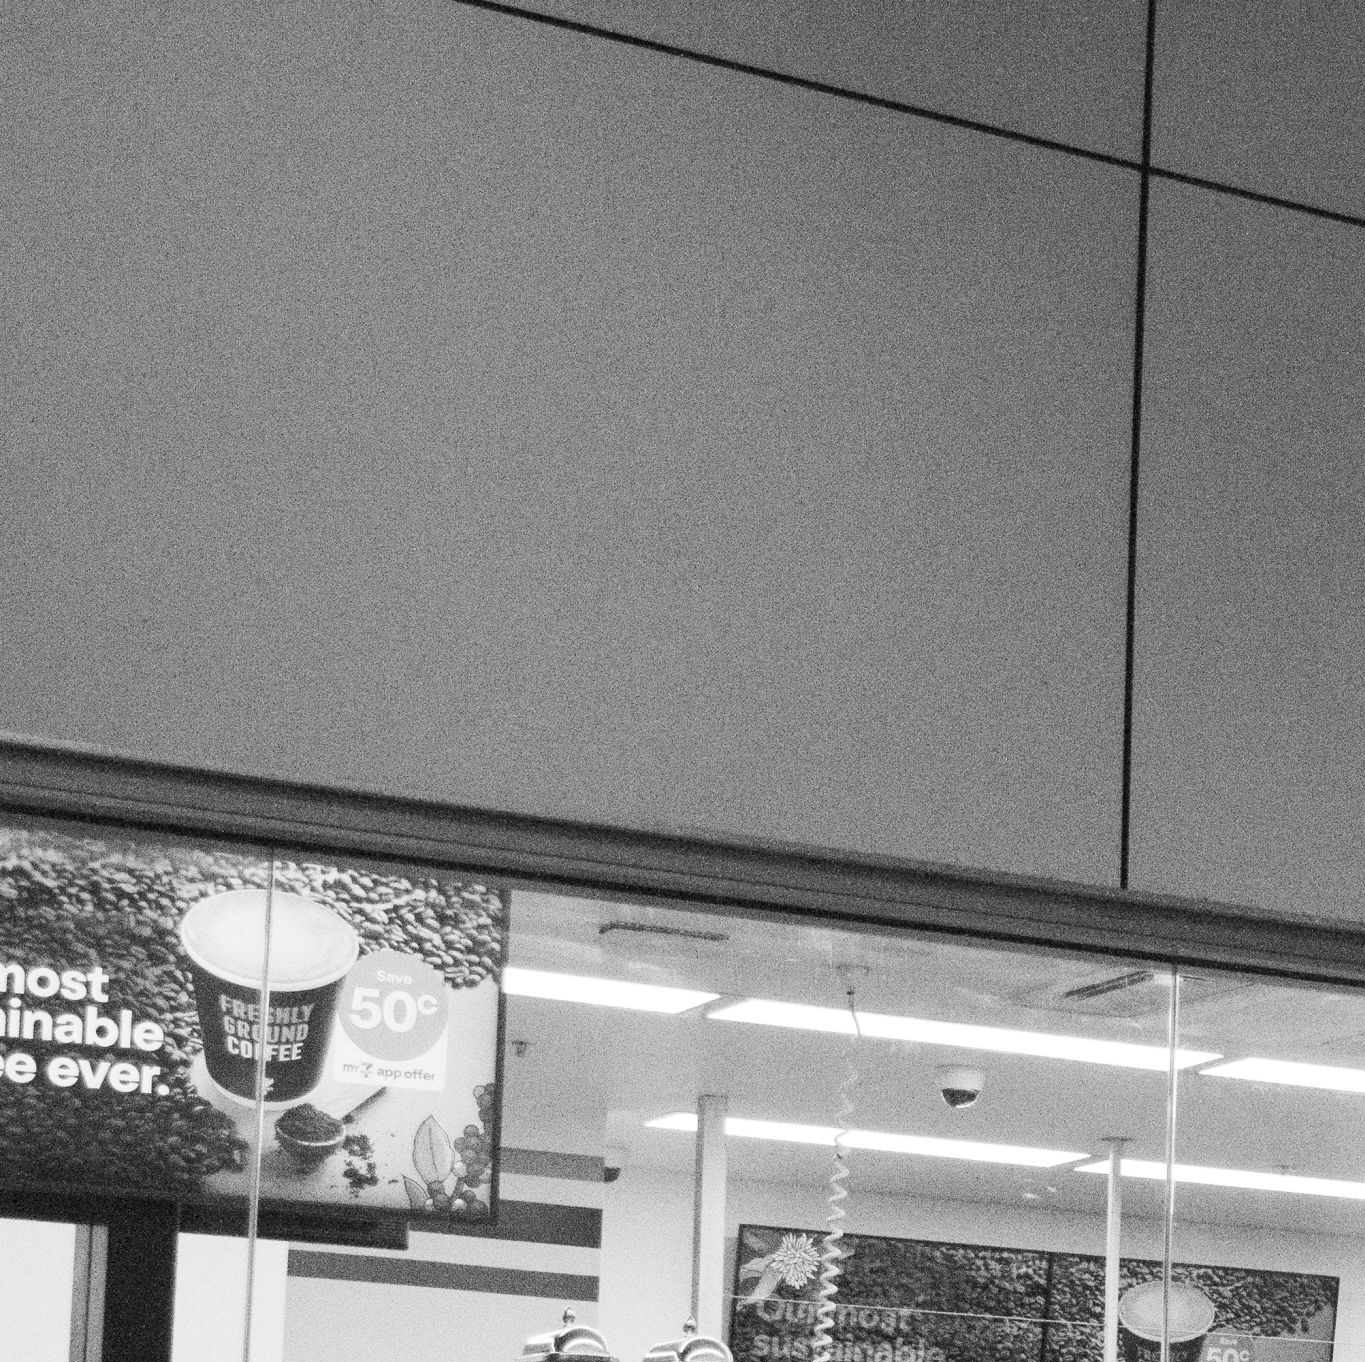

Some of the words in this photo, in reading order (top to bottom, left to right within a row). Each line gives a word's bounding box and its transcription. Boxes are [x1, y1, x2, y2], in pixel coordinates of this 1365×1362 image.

[377, 970, 413, 985] Save
[0, 998, 164, 1051] inable
[223, 1015, 309, 1043] GROUND
[47, 1057, 170, 1095] ever.
[377, 1067, 401, 1081] app
[404, 1069, 436, 1081] offer
